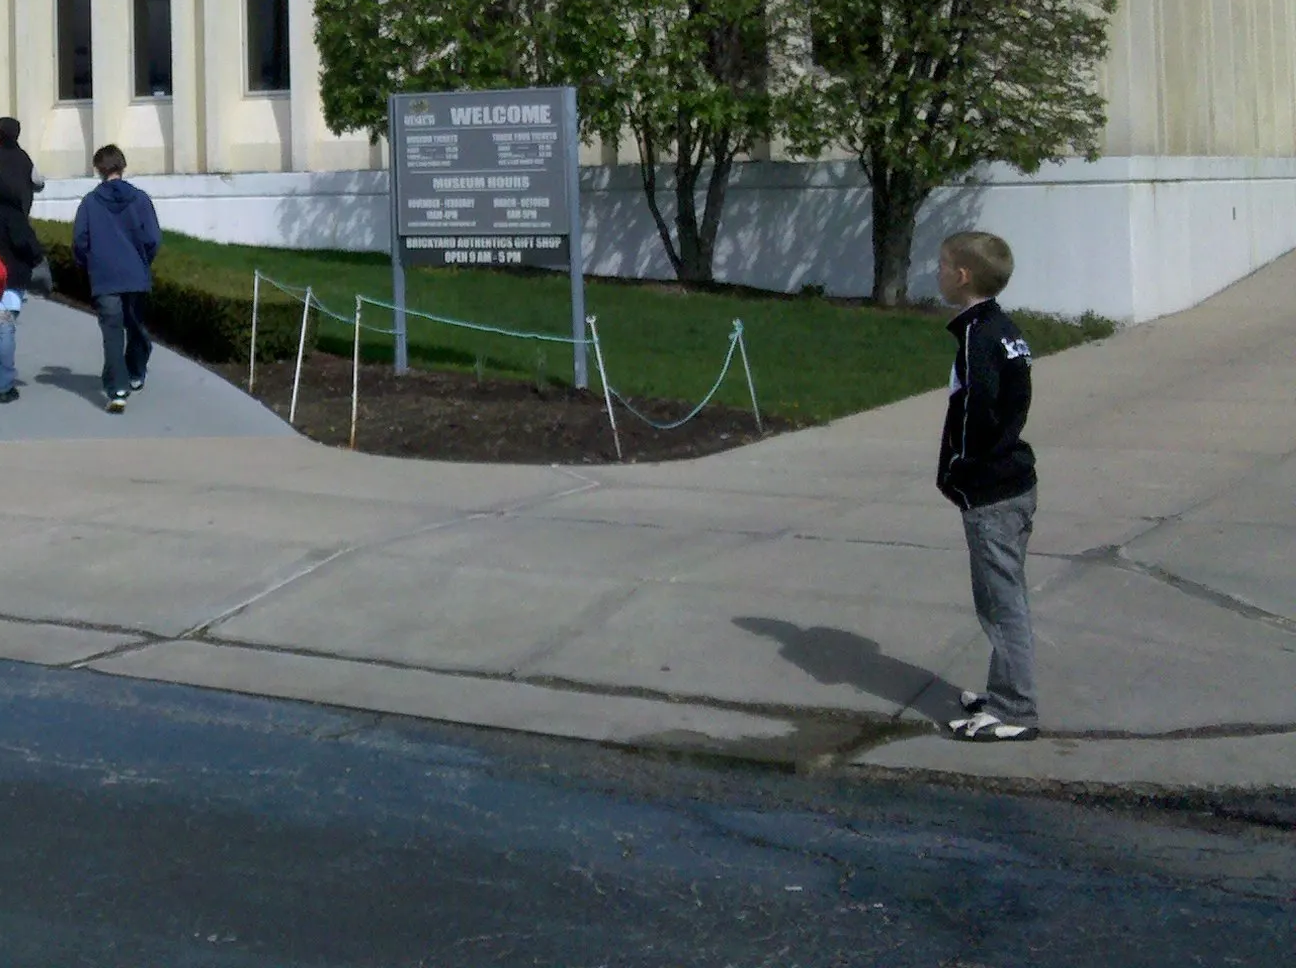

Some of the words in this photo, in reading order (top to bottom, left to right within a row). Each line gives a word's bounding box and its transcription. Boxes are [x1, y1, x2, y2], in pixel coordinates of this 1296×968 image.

[451, 105, 552, 126] WELCOME
[433, 177, 485, 189] MUSEUM
[488, 176, 531, 189] HOURS
[407, 237, 456, 249] BRICKYARD
[458, 237, 513, 249] AUTHENTICS
[514, 237, 535, 248] GIFT
[536, 237, 562, 248] SHOP
[445, 252, 469, 263] OPEN
[469, 252, 476, 263] 9
[478, 252, 493, 263] AM
[507, 252, 522, 263] PM
